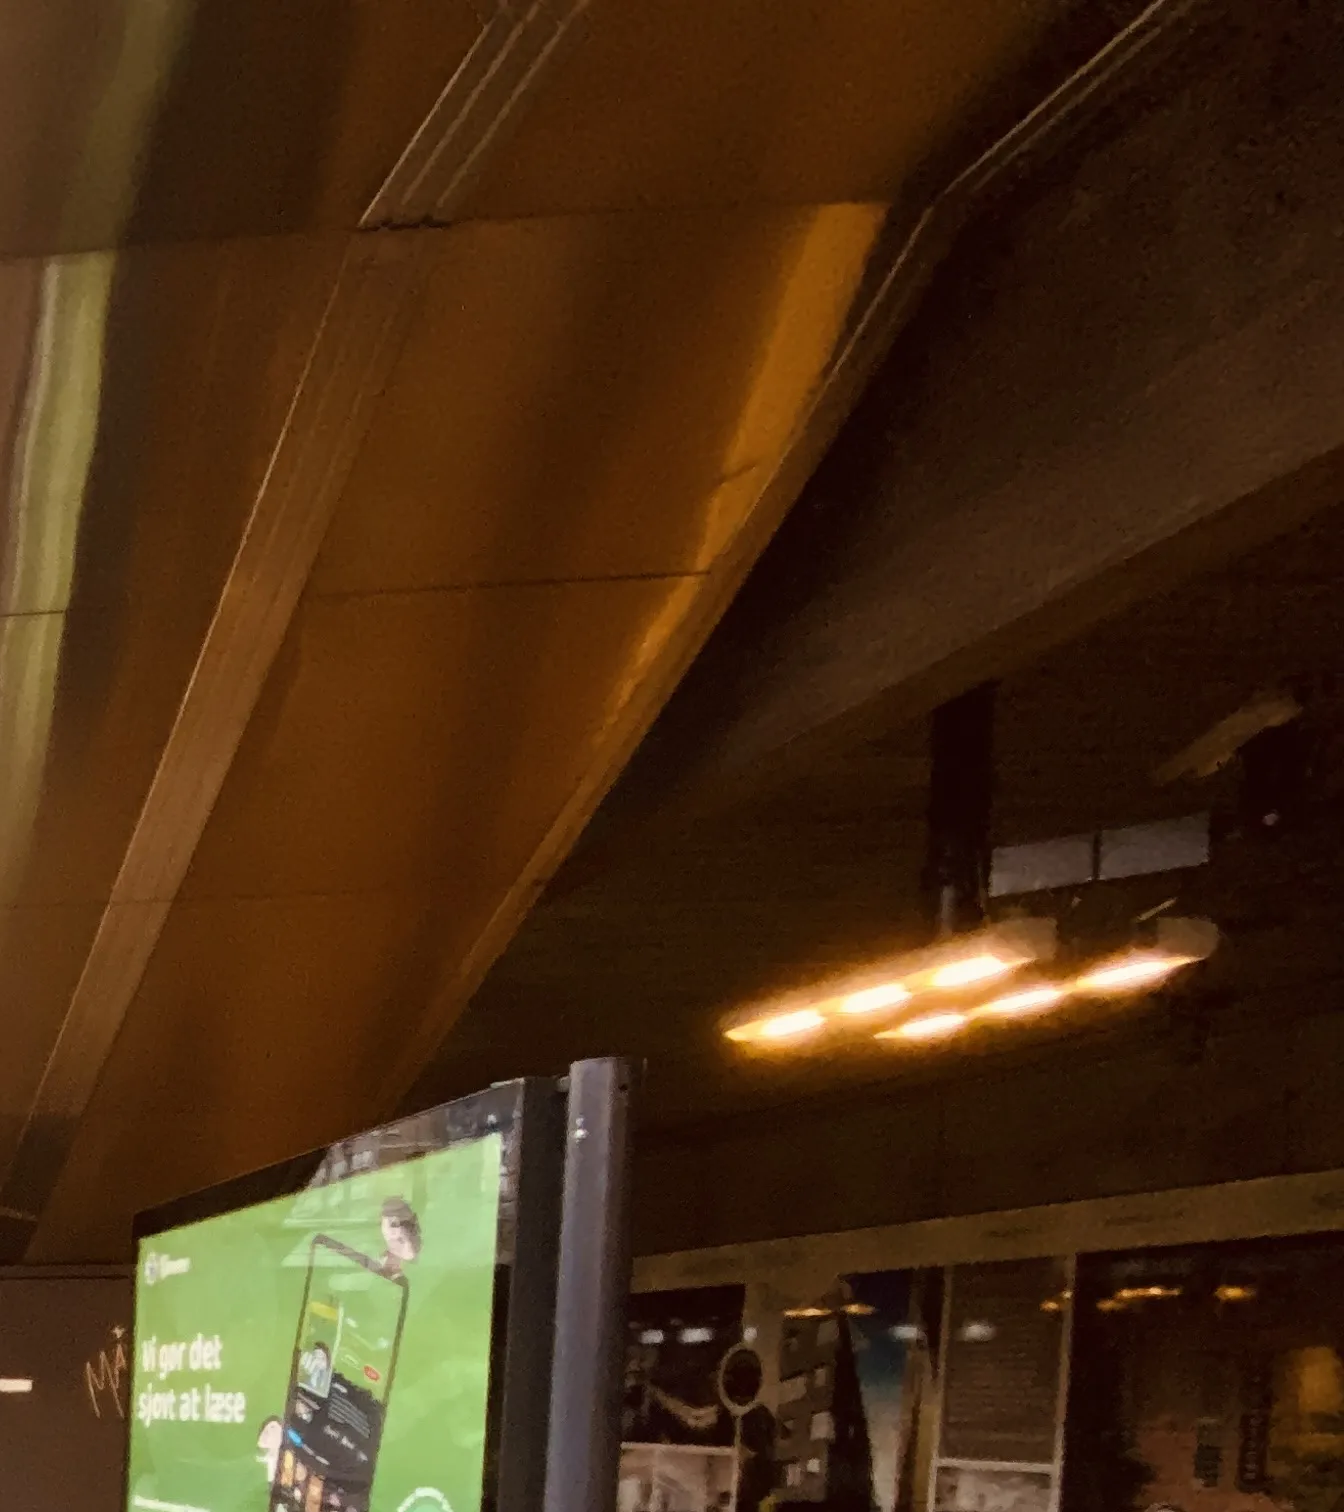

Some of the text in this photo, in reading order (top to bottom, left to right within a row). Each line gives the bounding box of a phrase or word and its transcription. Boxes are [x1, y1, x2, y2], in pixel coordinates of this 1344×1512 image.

[189, 1332, 223, 1371] det
[137, 1382, 247, 1429] sjovt at læse
